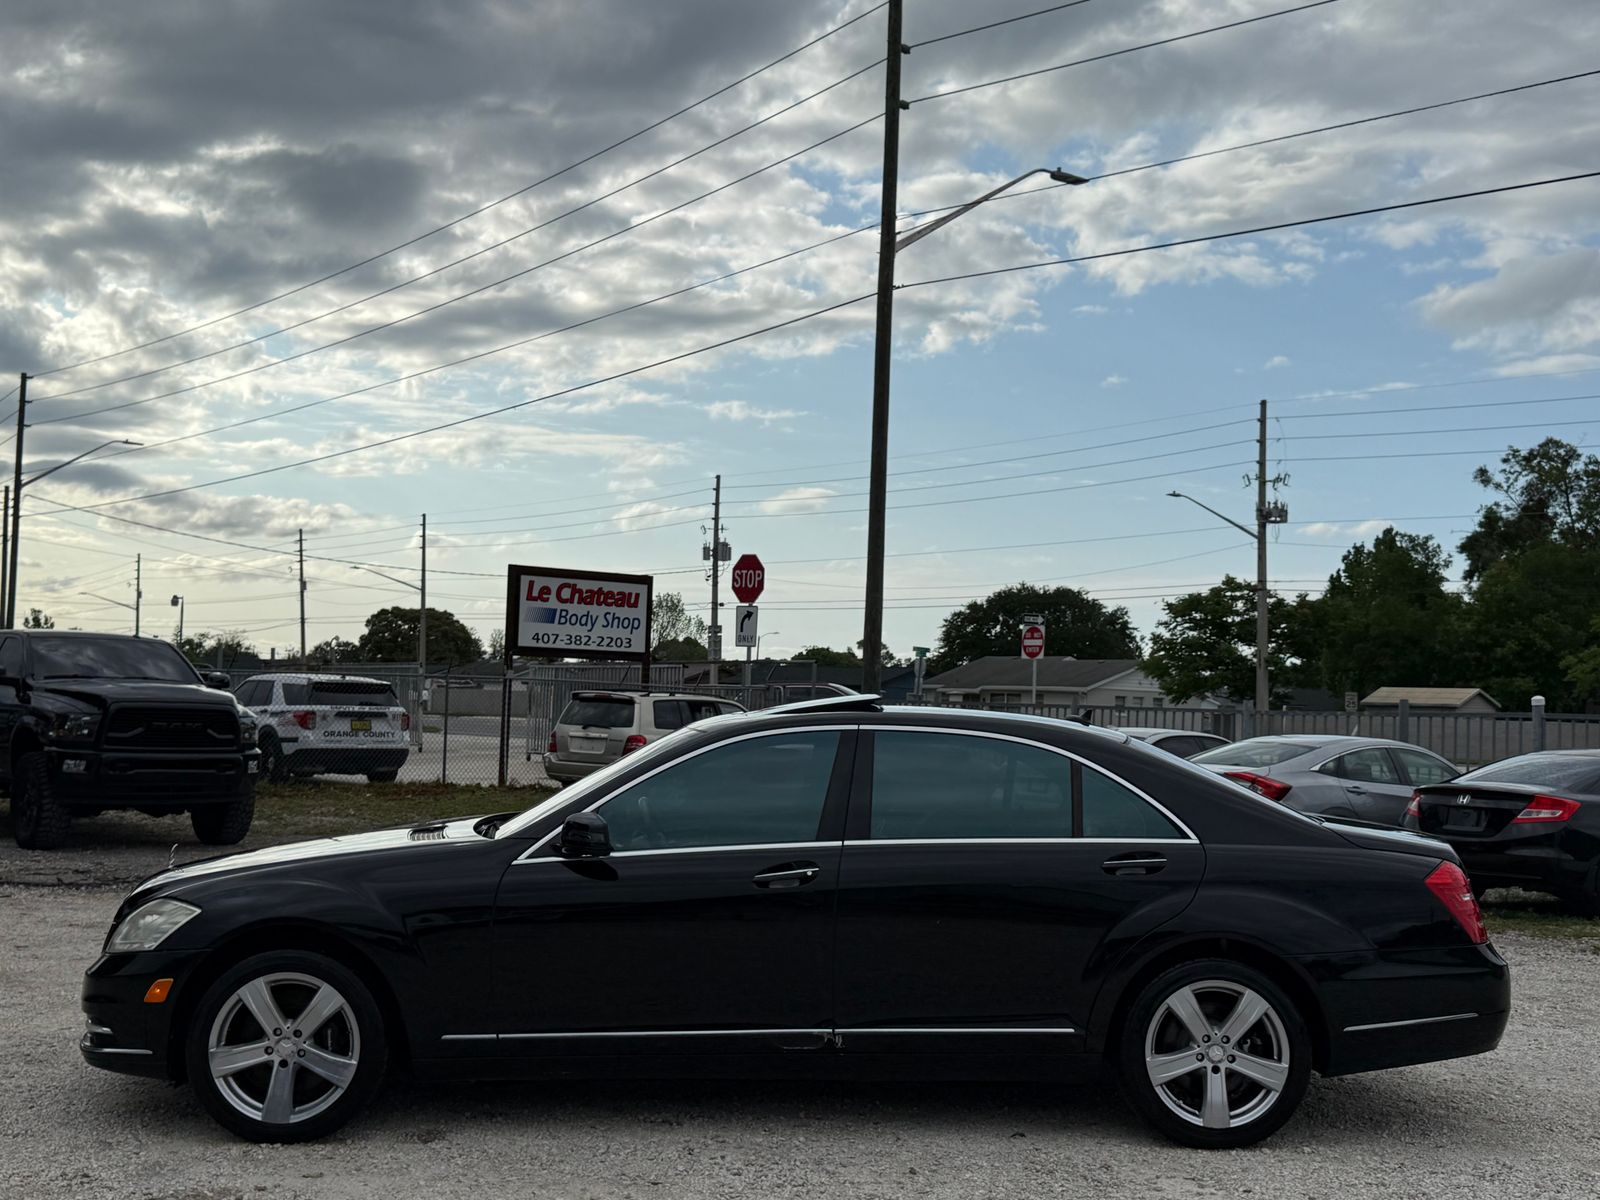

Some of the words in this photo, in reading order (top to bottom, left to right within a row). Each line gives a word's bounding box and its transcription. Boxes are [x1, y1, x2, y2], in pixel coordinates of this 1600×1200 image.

[734, 570, 762, 588] STOP
[526, 580, 551, 602] Le
[556, 583, 640, 608] Chateau
[558, 609, 599, 632] Body
[602, 612, 641, 635] Shop
[531, 632, 632, 649] 407-382-2203
[738, 634, 754, 643] ONLY
[1346, 700, 1357, 708] 25
[323, 730, 359, 738] ORANGE
[362, 730, 395, 738] COUNTY
